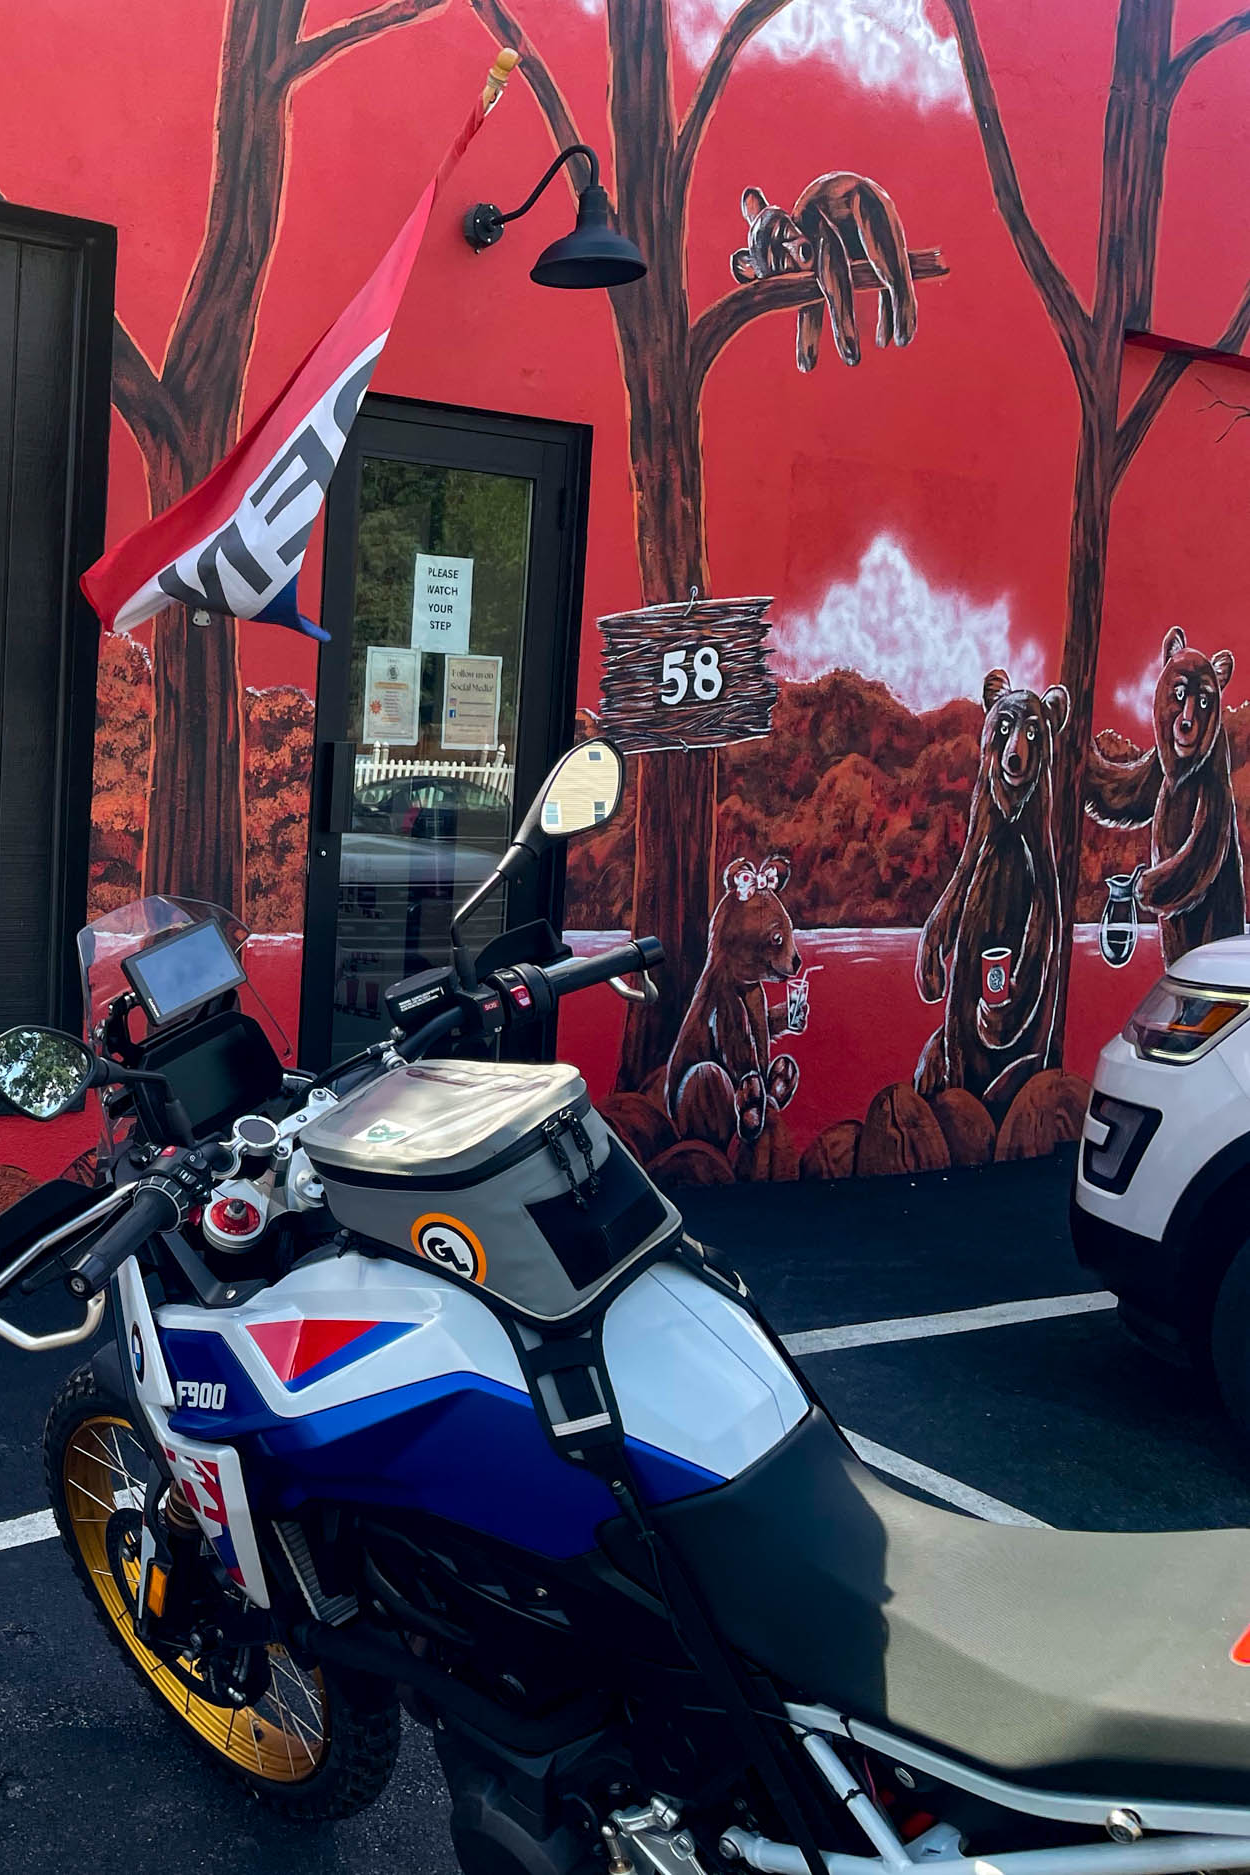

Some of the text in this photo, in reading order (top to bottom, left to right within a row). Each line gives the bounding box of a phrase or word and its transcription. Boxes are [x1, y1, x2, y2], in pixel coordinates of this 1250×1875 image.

[428, 566, 459, 579] PLEASE
[427, 583, 458, 596] WATCH
[428, 603, 453, 614] YOUR
[429, 620, 452, 631] STEP
[452, 668, 474, 678] Follow
[661, 646, 723, 706] 58
[450, 682, 471, 691] Social
[484, 1001, 498, 1011] SOS
[176, 1380, 227, 1410] F900
